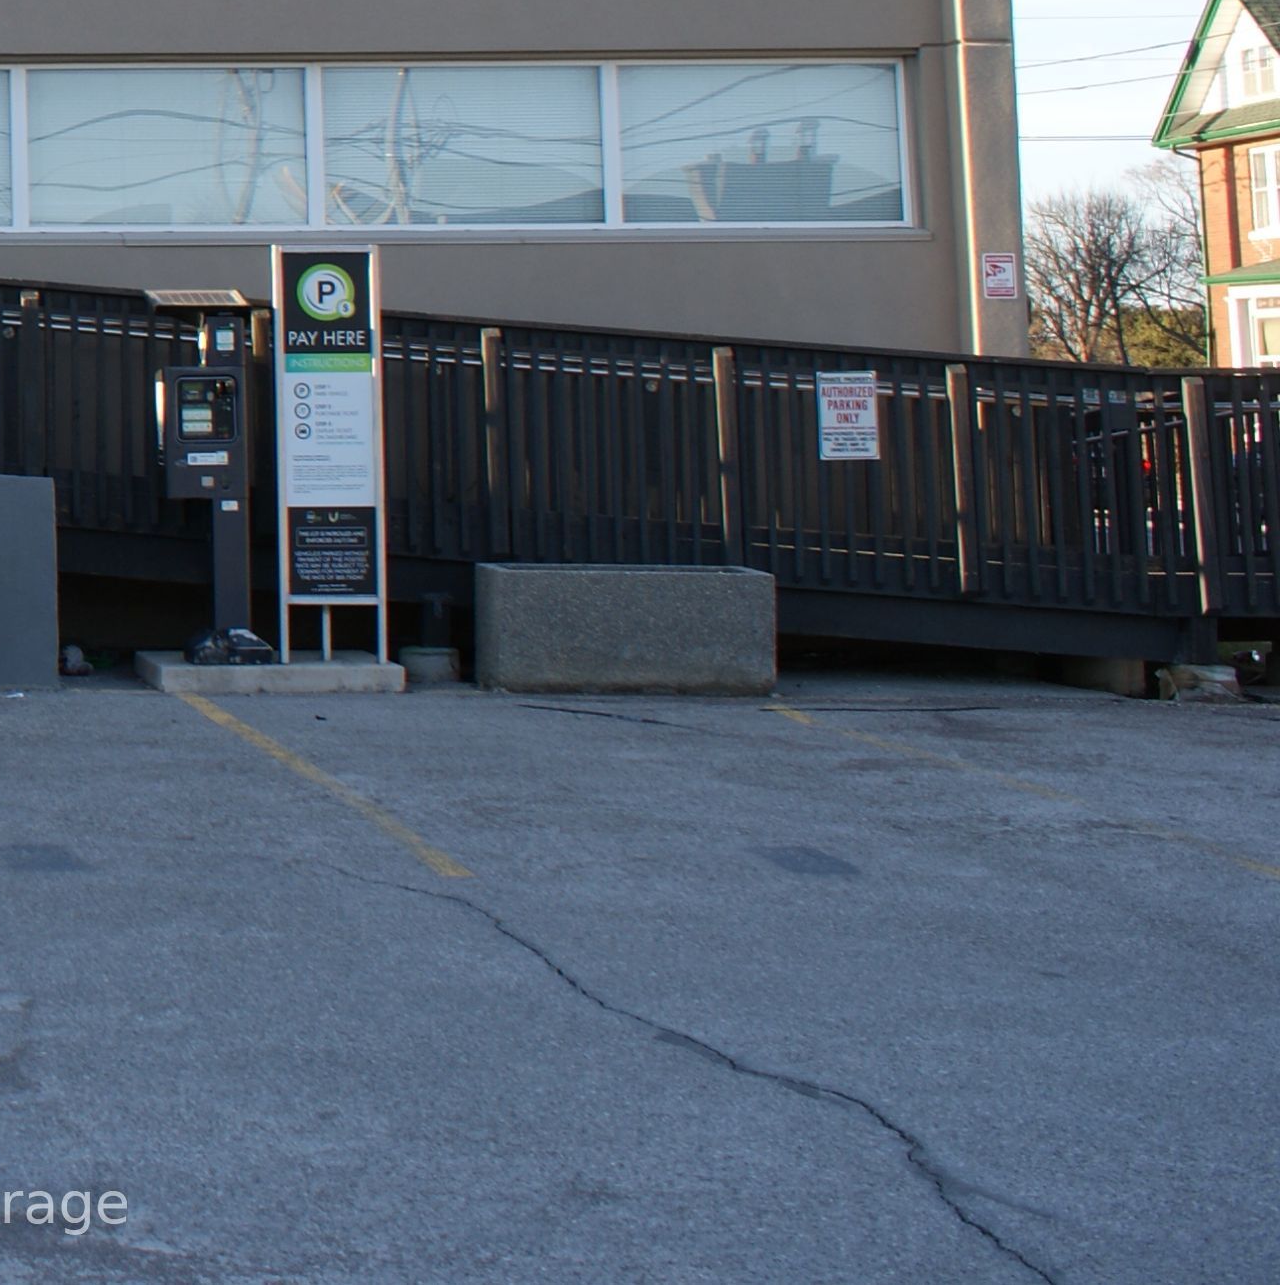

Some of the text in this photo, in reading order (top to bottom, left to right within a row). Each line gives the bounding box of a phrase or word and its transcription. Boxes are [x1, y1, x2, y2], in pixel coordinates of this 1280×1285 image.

[317, 280, 336, 305] P
[287, 330, 366, 346] PAY HERE
[821, 386, 874, 397] AUTHORIZED
[827, 399, 868, 411] PARKING
[836, 413, 860, 424] ONLY
